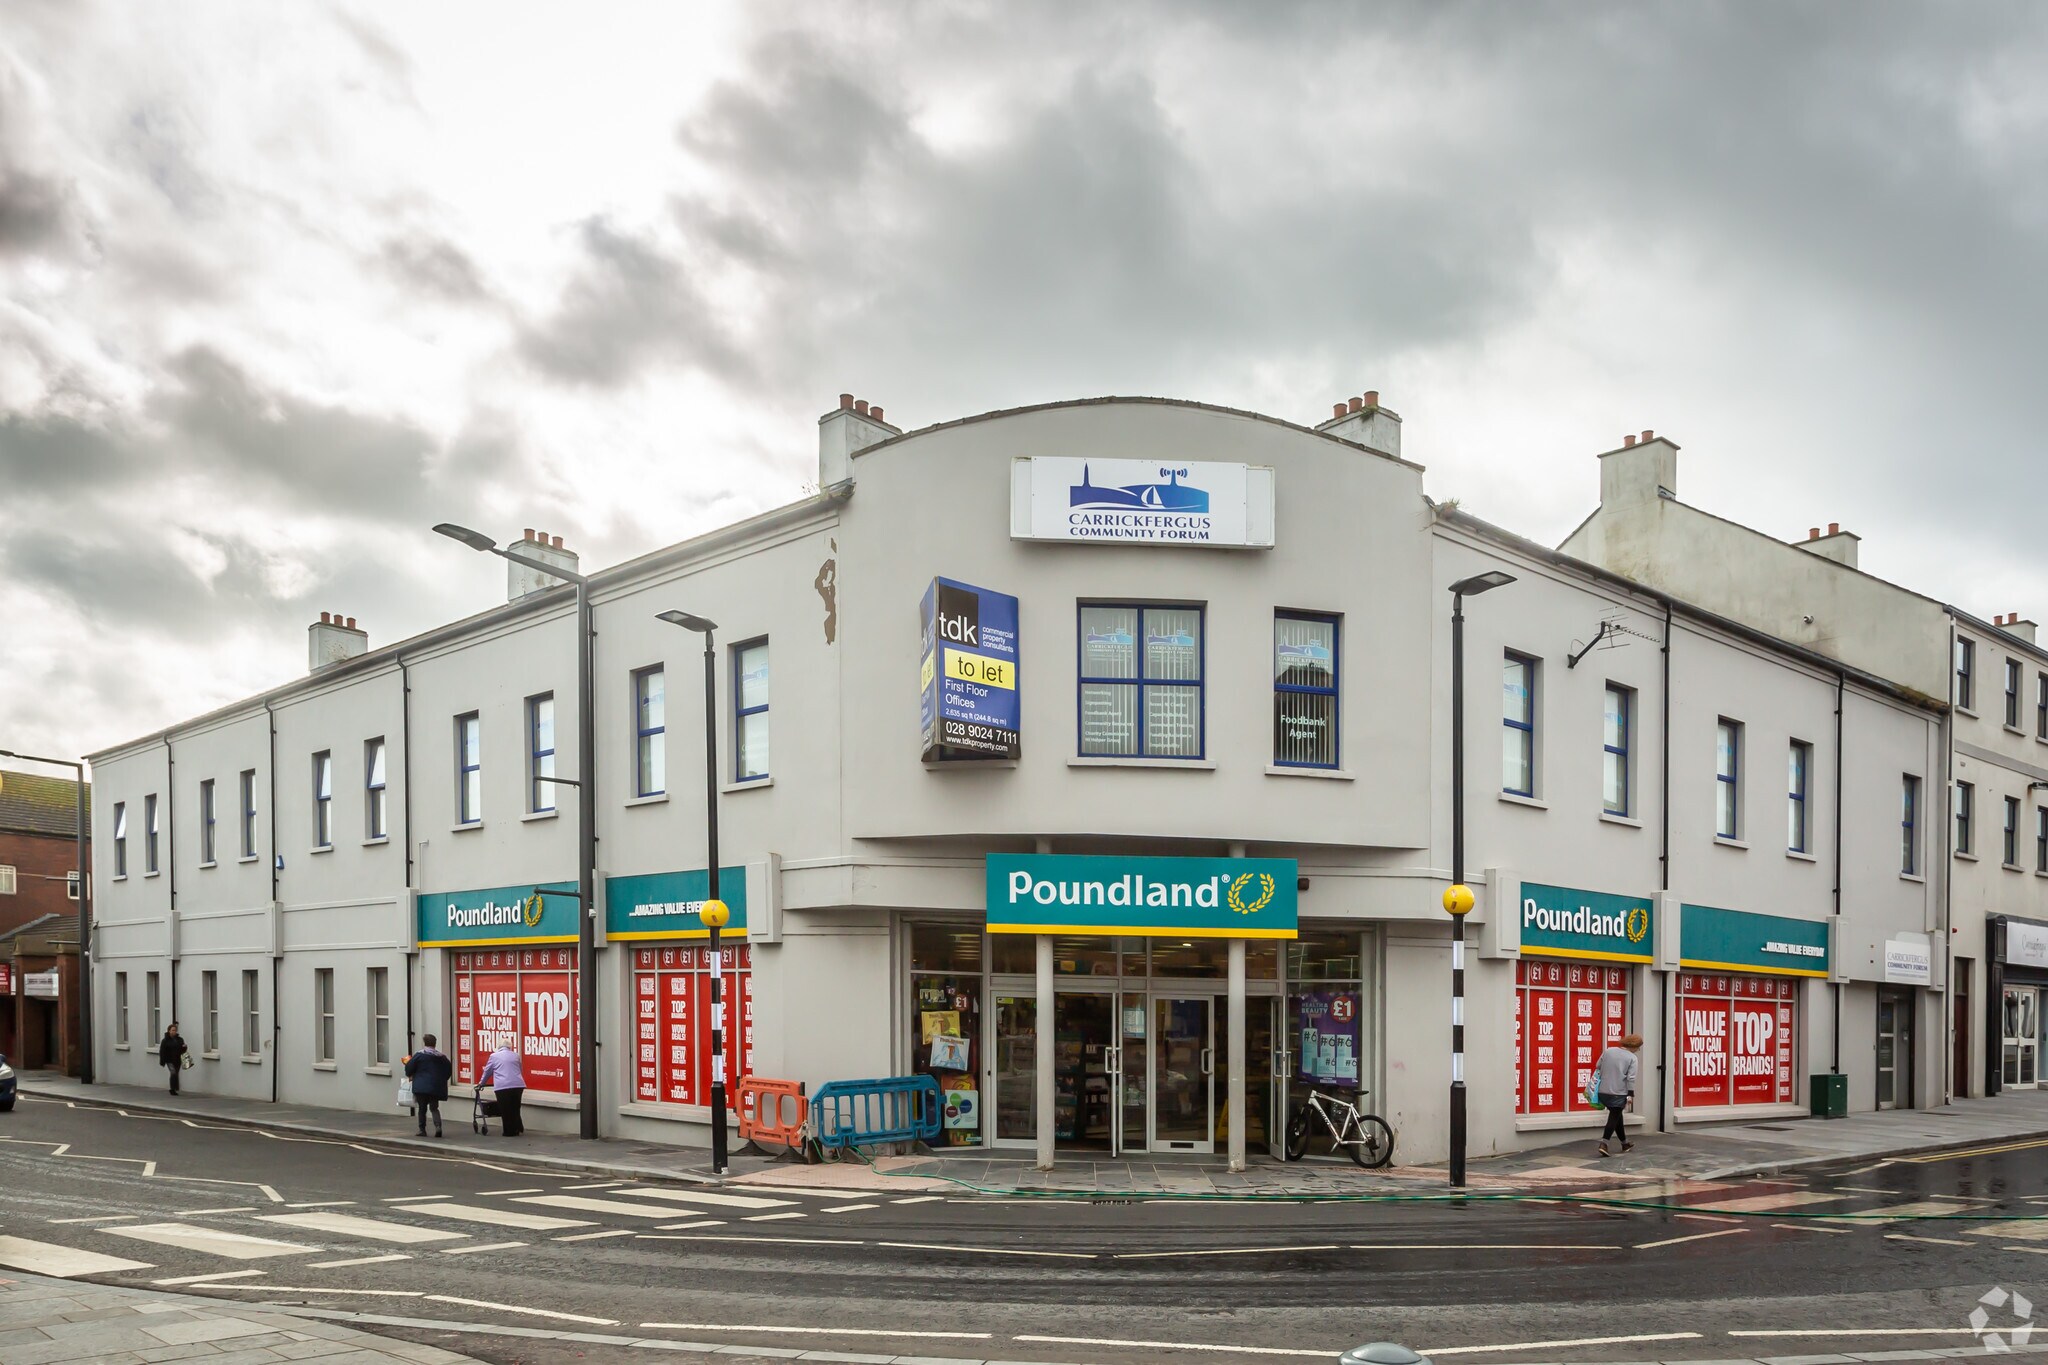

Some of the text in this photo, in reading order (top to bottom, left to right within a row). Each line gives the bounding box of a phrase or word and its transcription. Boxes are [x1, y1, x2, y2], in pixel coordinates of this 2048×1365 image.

[1069, 513, 1211, 529] CARRICKFERGUS
[1070, 527, 1210, 540] COMMUNITY FORUM
[939, 612, 978, 645] tdk
[982, 626, 1014, 639] commercial
[982, 633, 1006, 645] property
[982, 641, 1014, 653] consultants
[958, 656, 975, 677] to
[982, 660, 1003, 684] let
[945, 679, 989, 697] First Floor
[945, 693, 975, 709] Offices
[992, 718, 999, 726] sq
[1000, 719, 1007, 727] m)
[1280, 714, 1326, 727] Foodbank
[945, 721, 966, 736] 028
[968, 725, 993, 740] 9024
[996, 730, 1018, 745] 7111
[1289, 728, 1317, 740] Agent
[946, 736, 1008, 752] www.tdkproperty.com
[447, 899, 522, 928] Poundland
[664, 901, 686, 915] VALUE
[1523, 898, 1625, 938] Poundland
[723, 949, 732, 963] £1
[1788, 943, 1803, 955] VALUE
[476, 953, 515, 966] £1 £1 £1
[525, 953, 567, 966] £1 £1 £1
[642, 951, 651, 964] £1
[664, 950, 690, 964] £1 £1
[1532, 966, 1559, 981] £1 £1
[1571, 968, 1598, 984] £1 £1
[1610, 971, 1619, 985] £1
[1685, 977, 1726, 992] £1 £1 £1
[1734, 980, 1773, 994] £1 £1 £1
[477, 991, 517, 1016] VALUE
[640, 1000, 655, 1013] TOP
[671, 1000, 686, 1013] TOP
[955, 996, 967, 1008] £1
[1333, 1000, 1352, 1017] £1
[524, 991, 569, 1036] TOP
[481, 1016, 496, 1030] YOU
[496, 1016, 512, 1031] CAN
[1538, 1021, 1553, 1035] TOP
[1577, 1022, 1592, 1036] TOP
[1608, 1023, 1622, 1036] TOP
[1685, 1010, 1726, 1036] VALUE
[1304, 1031, 1317, 1042] #6
[1734, 1011, 1774, 1055] TOP
[1780, 1027, 1790, 1039] TOP
[524, 1035, 570, 1058] BRANDS!
[1320, 1036, 1352, 1047] #6 #6
[1689, 1036, 1722, 1052] YOU CAN
[1325, 1058, 1358, 1067] #6 #6
[1684, 1052, 1727, 1077] TRUST!
[1733, 1055, 1774, 1076] BRANDS!
